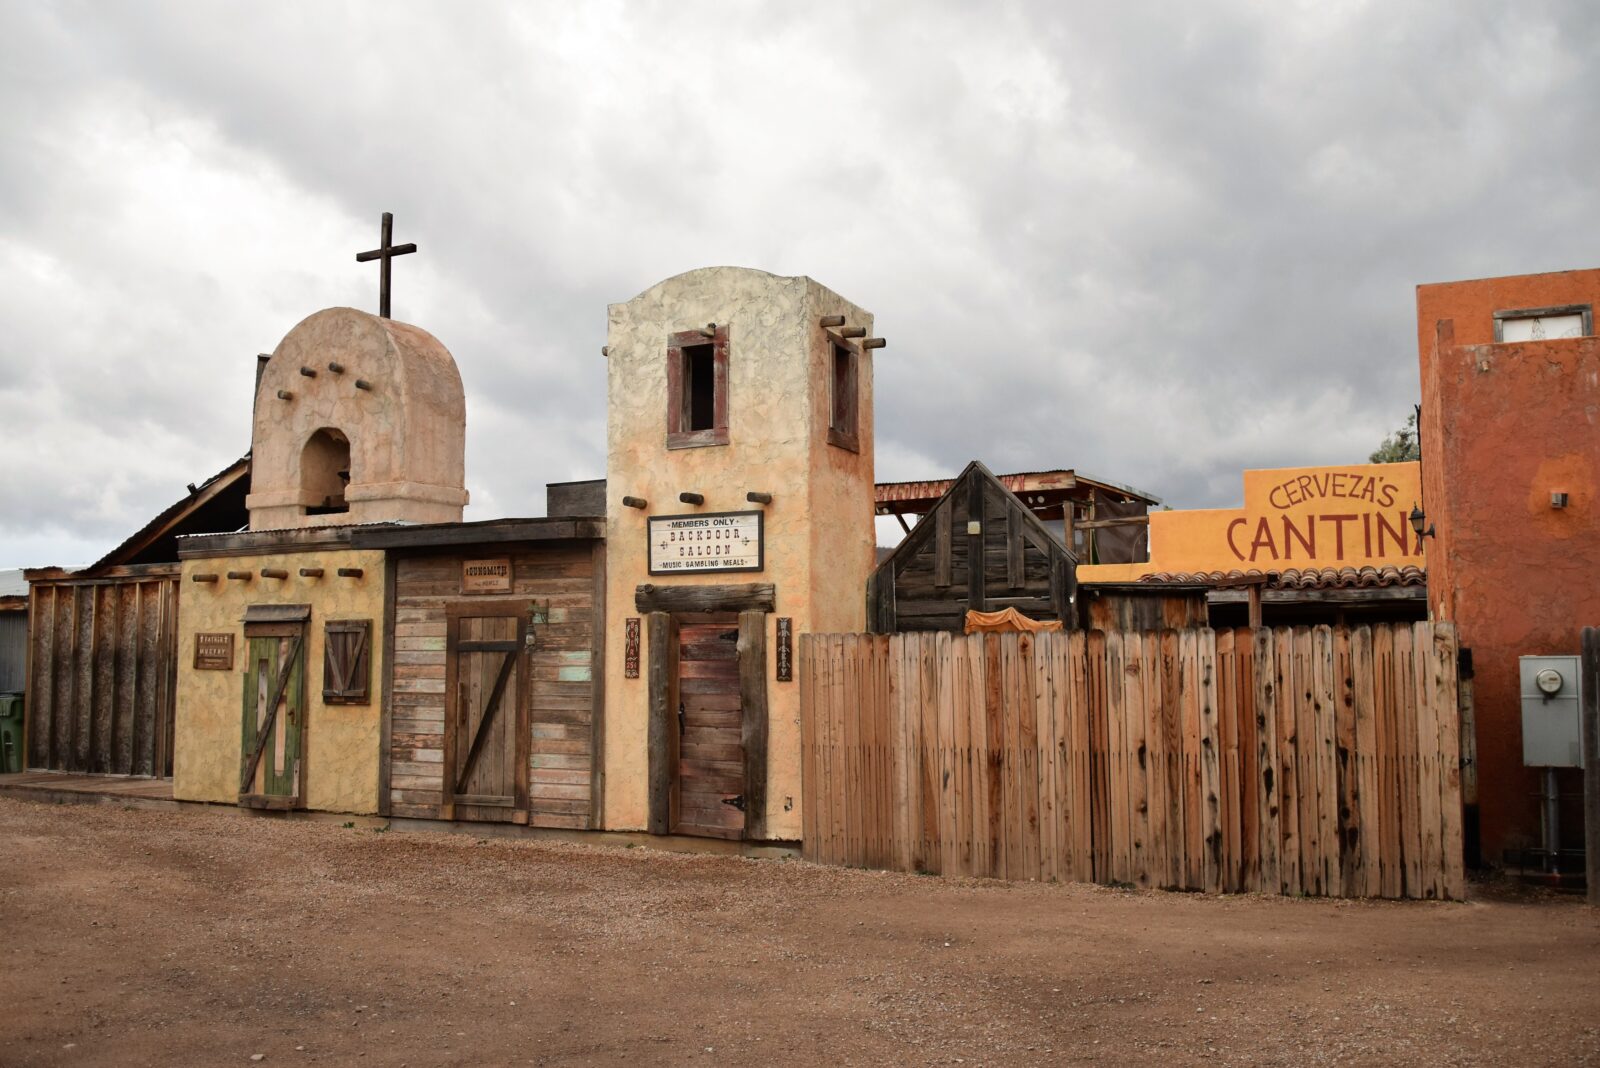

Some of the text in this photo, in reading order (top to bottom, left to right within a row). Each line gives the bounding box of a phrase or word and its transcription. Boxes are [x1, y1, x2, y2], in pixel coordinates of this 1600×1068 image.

[1269, 472, 1399, 510] CERVEZA'S
[671, 518, 735, 528] MEMBERS ONLY
[670, 529, 740, 542] BACKDOOR
[1226, 511, 1421, 562] CANTIN
[679, 545, 731, 557] SALOON
[685, 560, 719, 568] GAMBLING
[723, 559, 744, 567] MEALS
